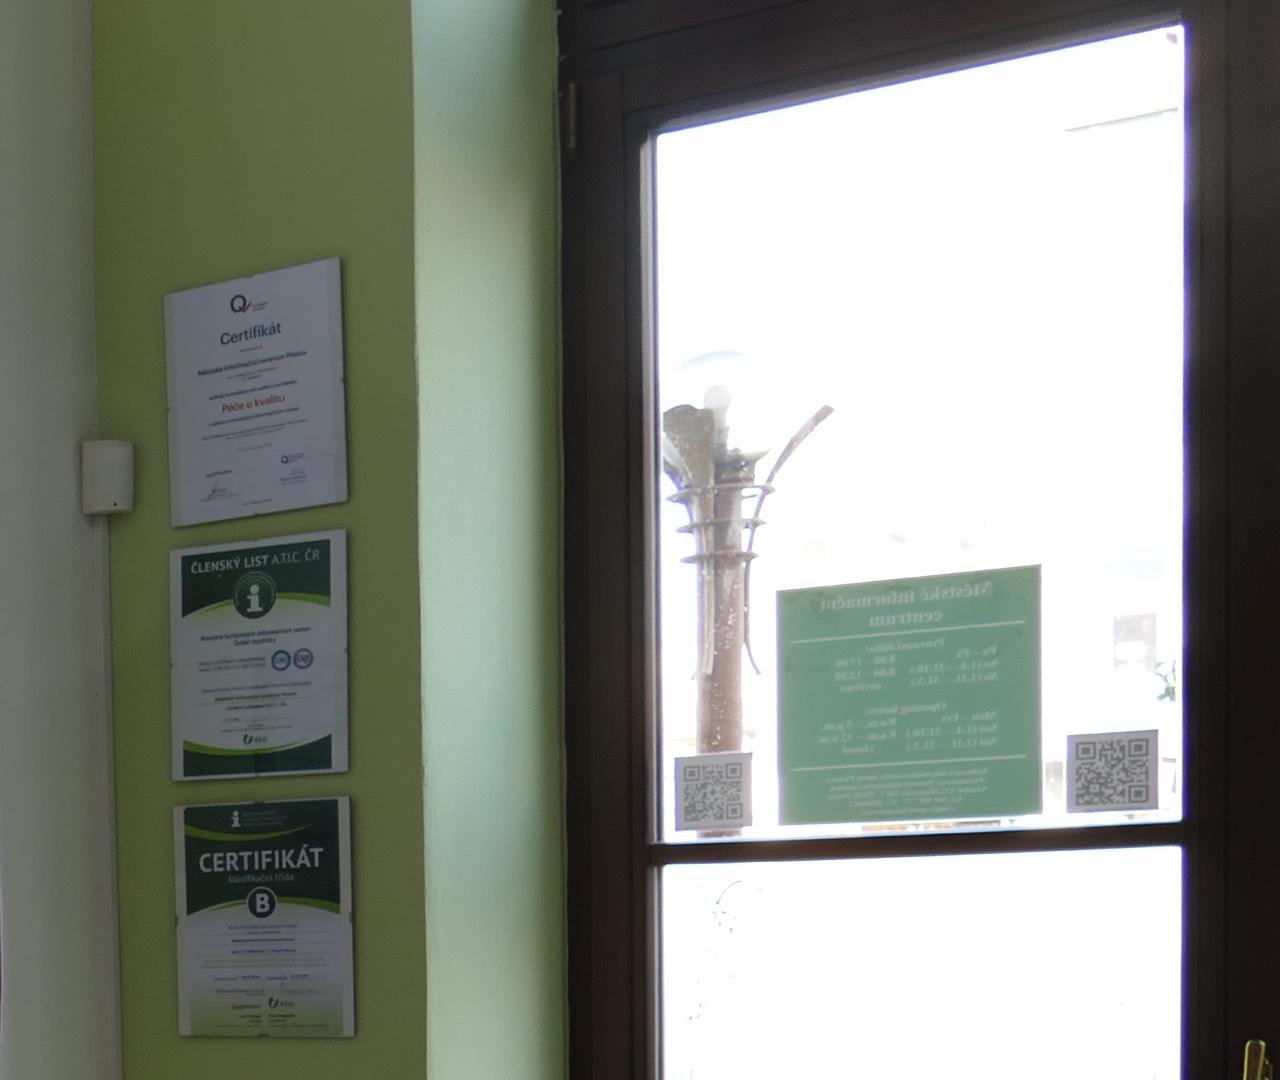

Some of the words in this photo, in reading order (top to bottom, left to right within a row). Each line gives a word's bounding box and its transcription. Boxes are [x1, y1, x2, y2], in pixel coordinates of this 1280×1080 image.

[220, 322, 282, 347] Certifikát
[254, 394, 285, 409] kvalitu
[191, 557, 240, 575] ČLENSKÝ
[244, 554, 269, 569] LIST
[305, 548, 321, 561] ČR
[199, 844, 324, 873] CERTIFIKÁT
[254, 891, 271, 914] B
